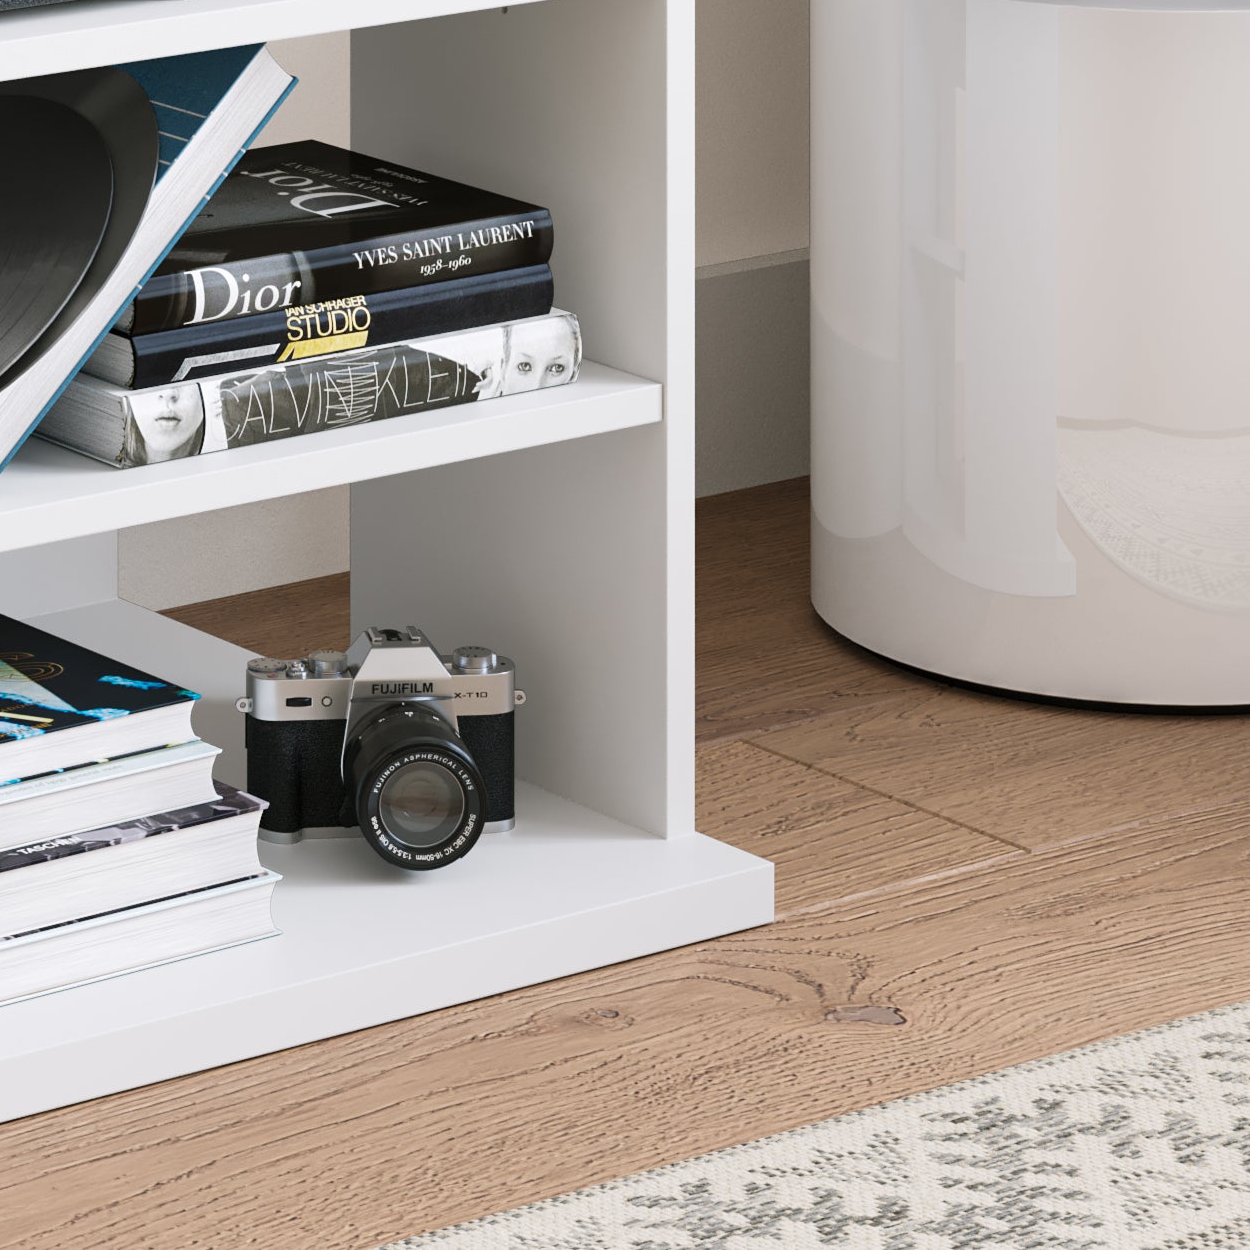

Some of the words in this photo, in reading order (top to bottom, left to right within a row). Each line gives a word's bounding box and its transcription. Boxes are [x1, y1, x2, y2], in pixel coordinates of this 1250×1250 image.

[240, 169, 401, 219] Dior
[352, 249, 399, 270] YVES
[403, 235, 453, 261] SAINT
[458, 220, 535, 251] LAURENT
[183, 267, 301, 325] Dior
[305, 295, 367, 313] SCHRAGER
[286, 306, 371, 341] STUDIO
[371, 682, 434, 695] FUJIFILM
[453, 691, 488, 699] X-T10
[373, 761, 401, 793] FUJINON
[403, 753, 457, 769] ASPHERICAL
[458, 769, 474, 791] LENS
[462, 813, 477, 838] SUPER
[16, 836, 82, 855] TASCHEN
